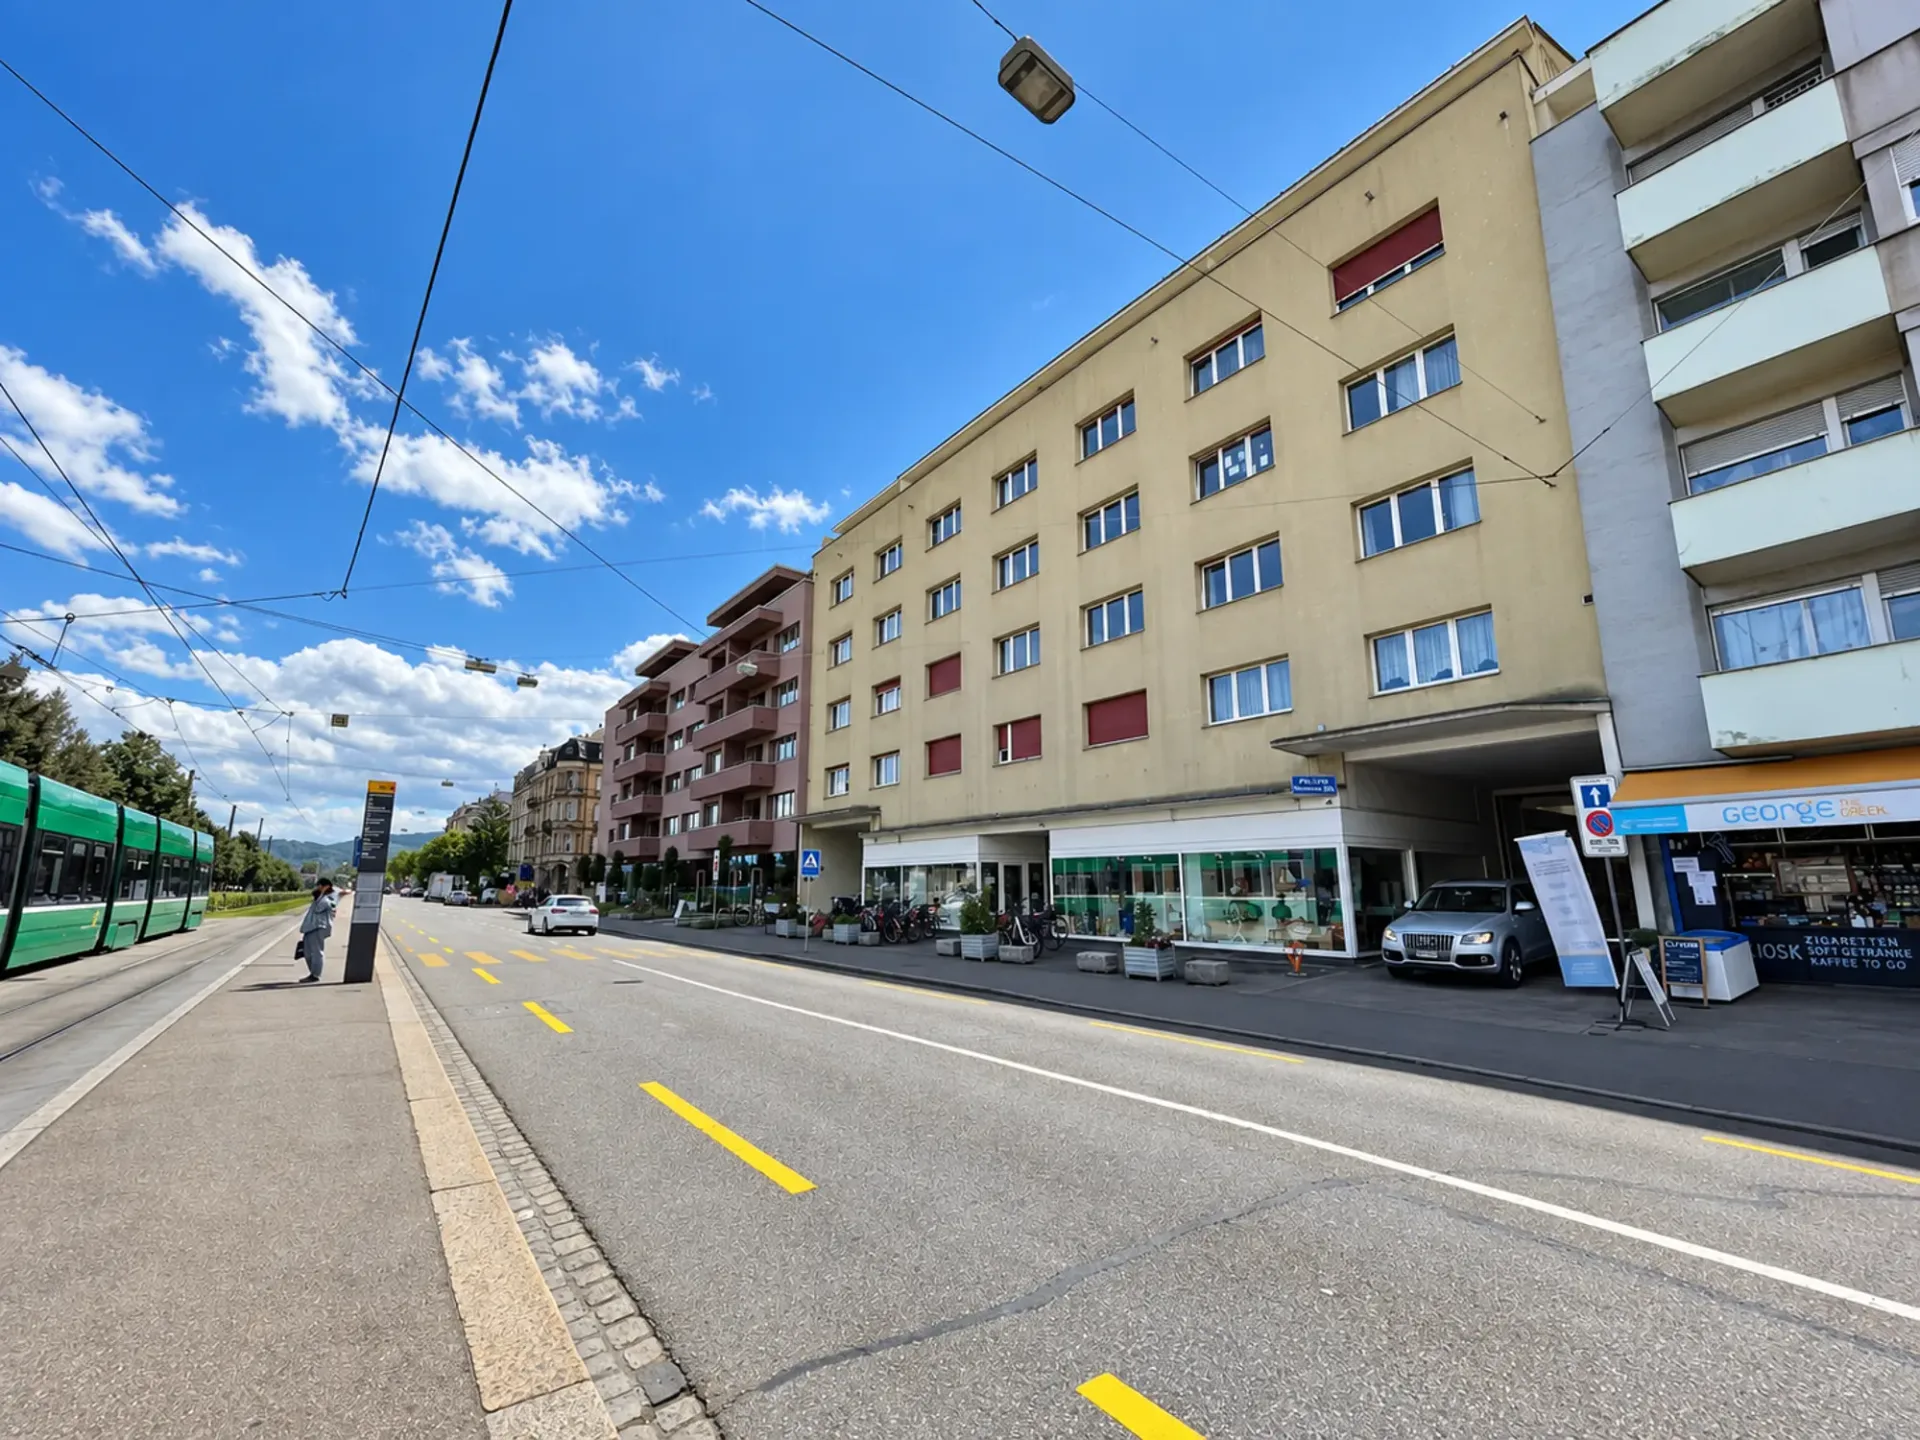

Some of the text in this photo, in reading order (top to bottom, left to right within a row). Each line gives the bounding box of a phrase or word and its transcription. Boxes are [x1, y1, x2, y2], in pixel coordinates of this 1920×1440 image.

[1804, 935, 1899, 947] ZIGARETTEN
[1807, 946, 1838, 956] SOFT
[1810, 957, 1907, 970] KAFFEE TO GO
